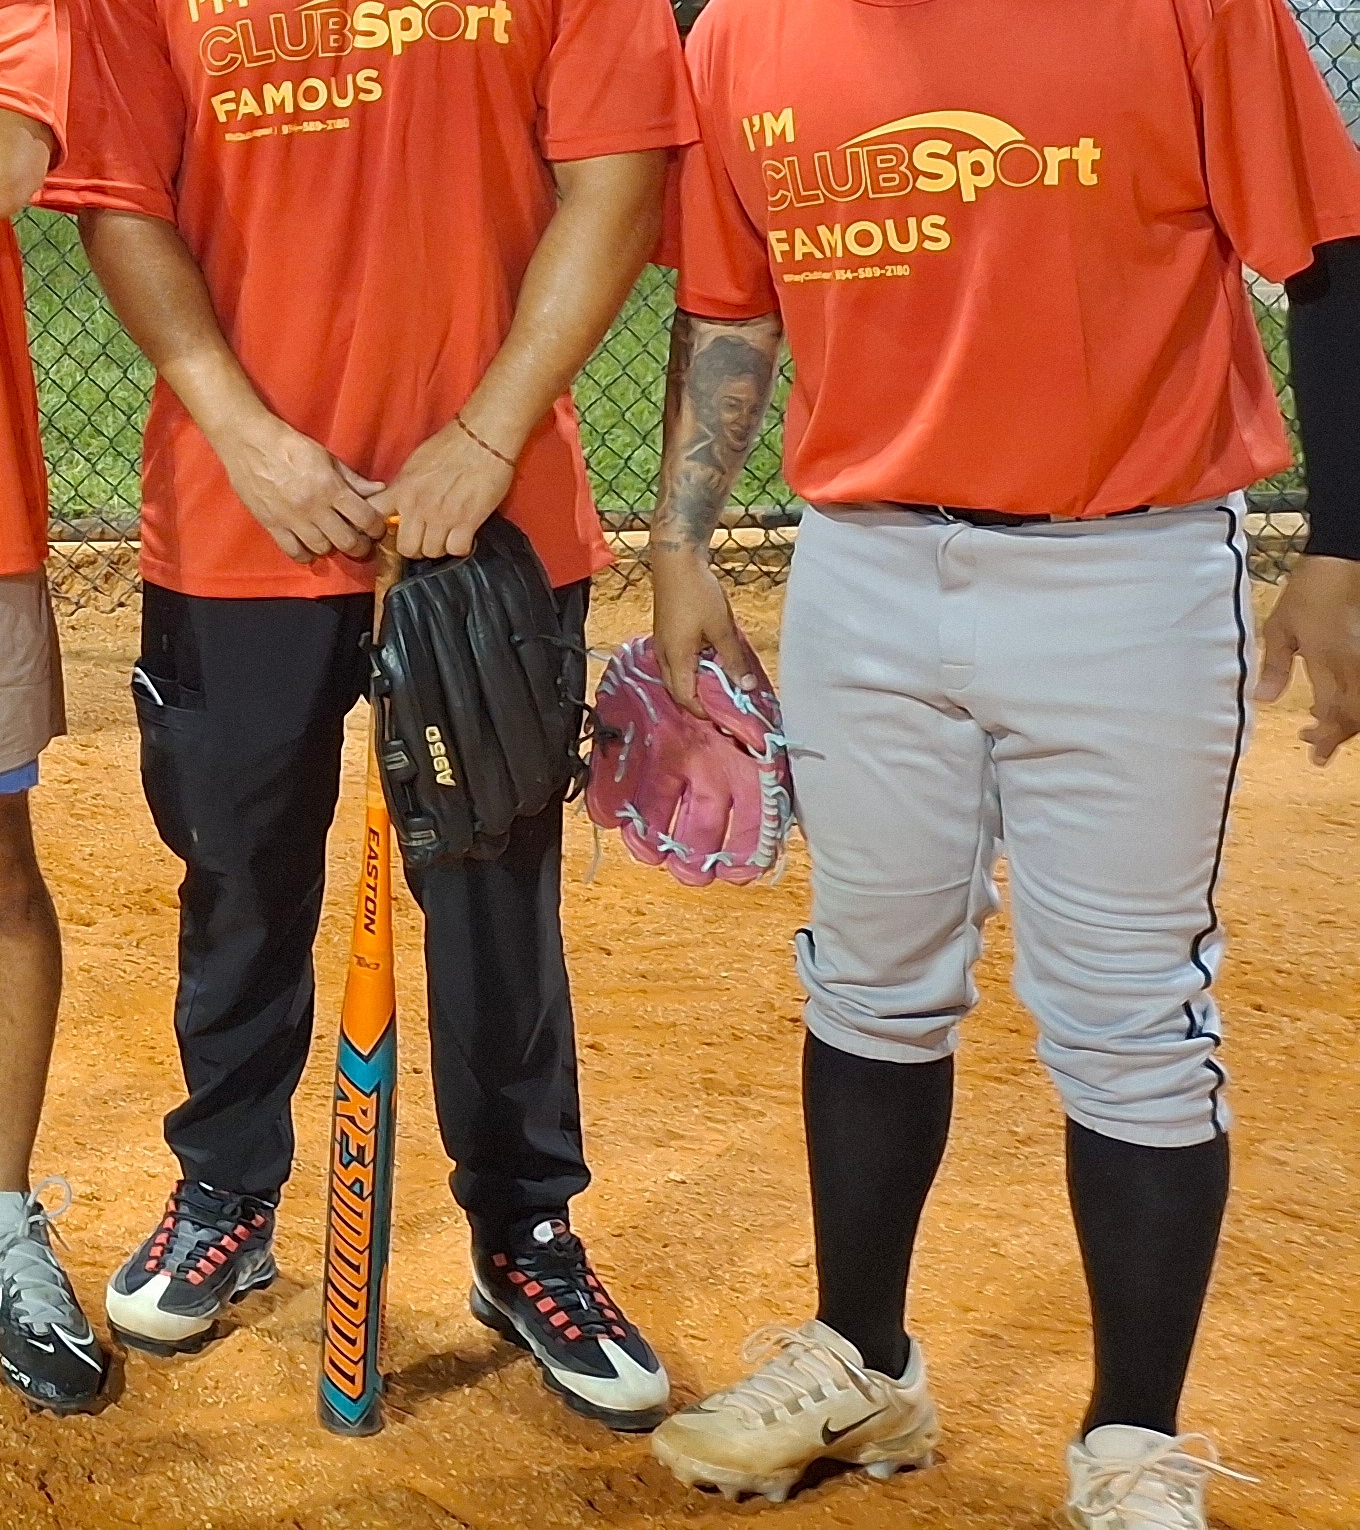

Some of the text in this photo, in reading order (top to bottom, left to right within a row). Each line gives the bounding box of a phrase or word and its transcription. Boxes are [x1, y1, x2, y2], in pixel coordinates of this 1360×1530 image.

[211, 69, 382, 123] FAMOUS
[742, 107, 795, 151] I'M
[768, 215, 951, 263] FAMOUS
[363, 826, 380, 936] EASTON
